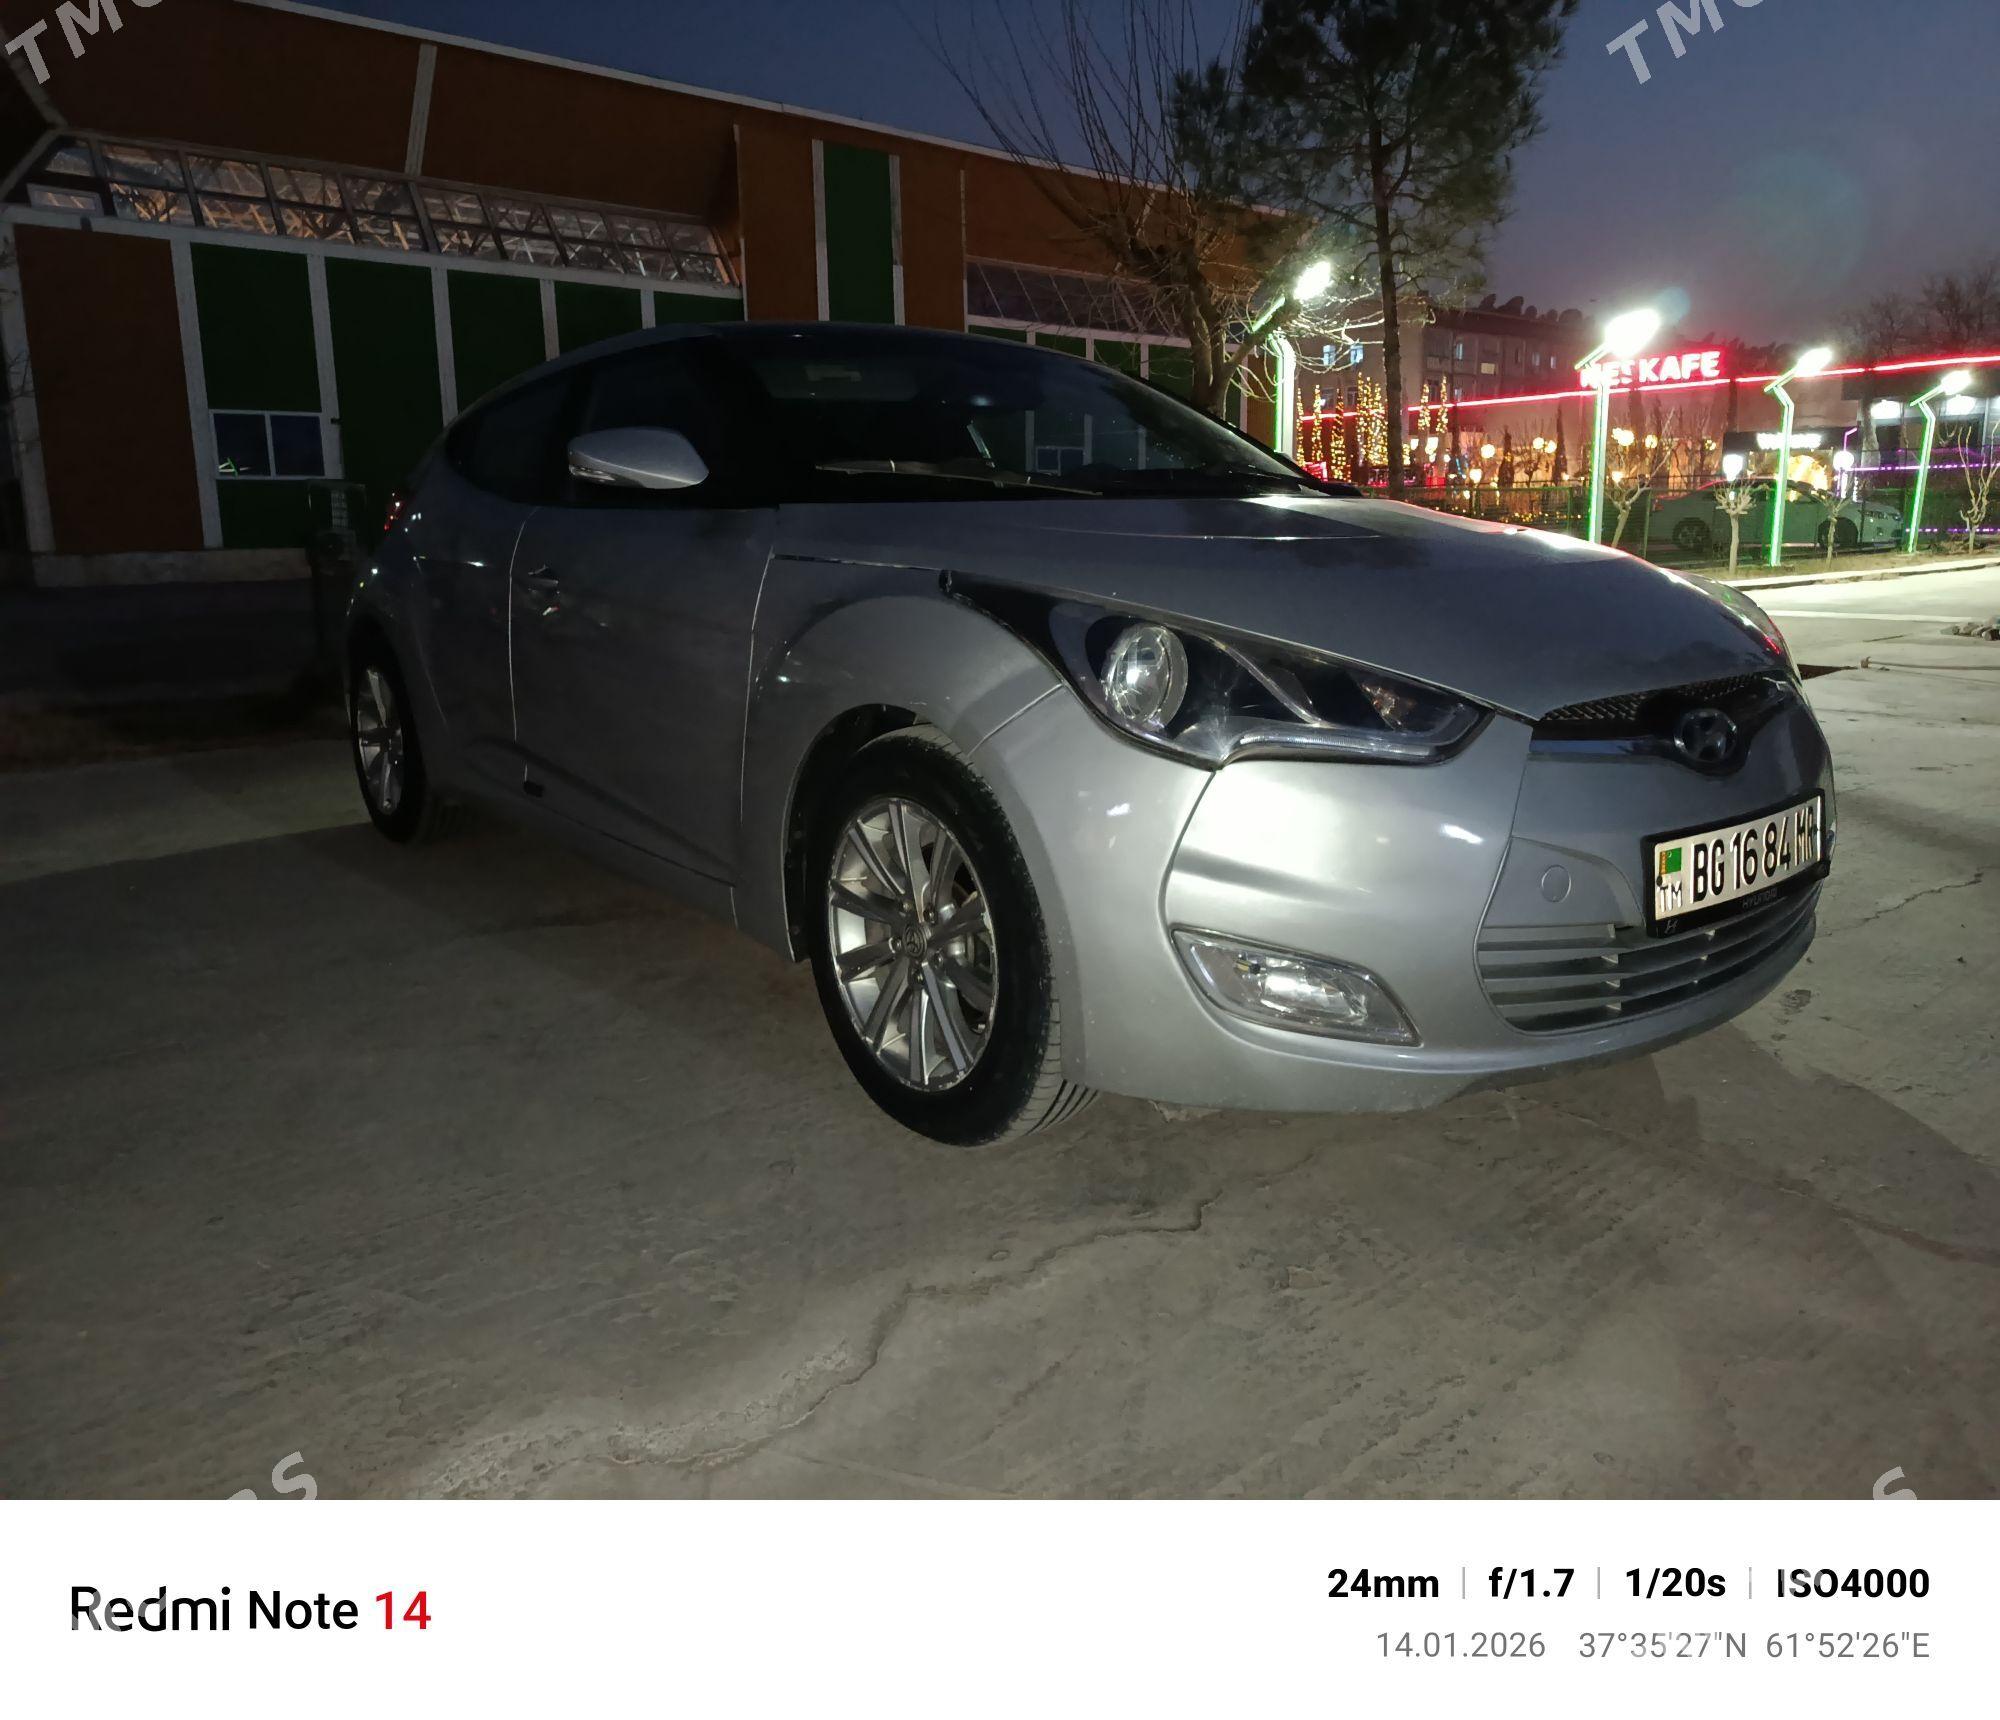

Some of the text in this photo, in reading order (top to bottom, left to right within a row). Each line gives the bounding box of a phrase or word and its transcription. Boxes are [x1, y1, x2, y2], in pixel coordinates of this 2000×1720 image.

[1639, 350, 1721, 383] KAFE
[1689, 838, 1725, 904] BG
[1656, 880, 1682, 913] TM
